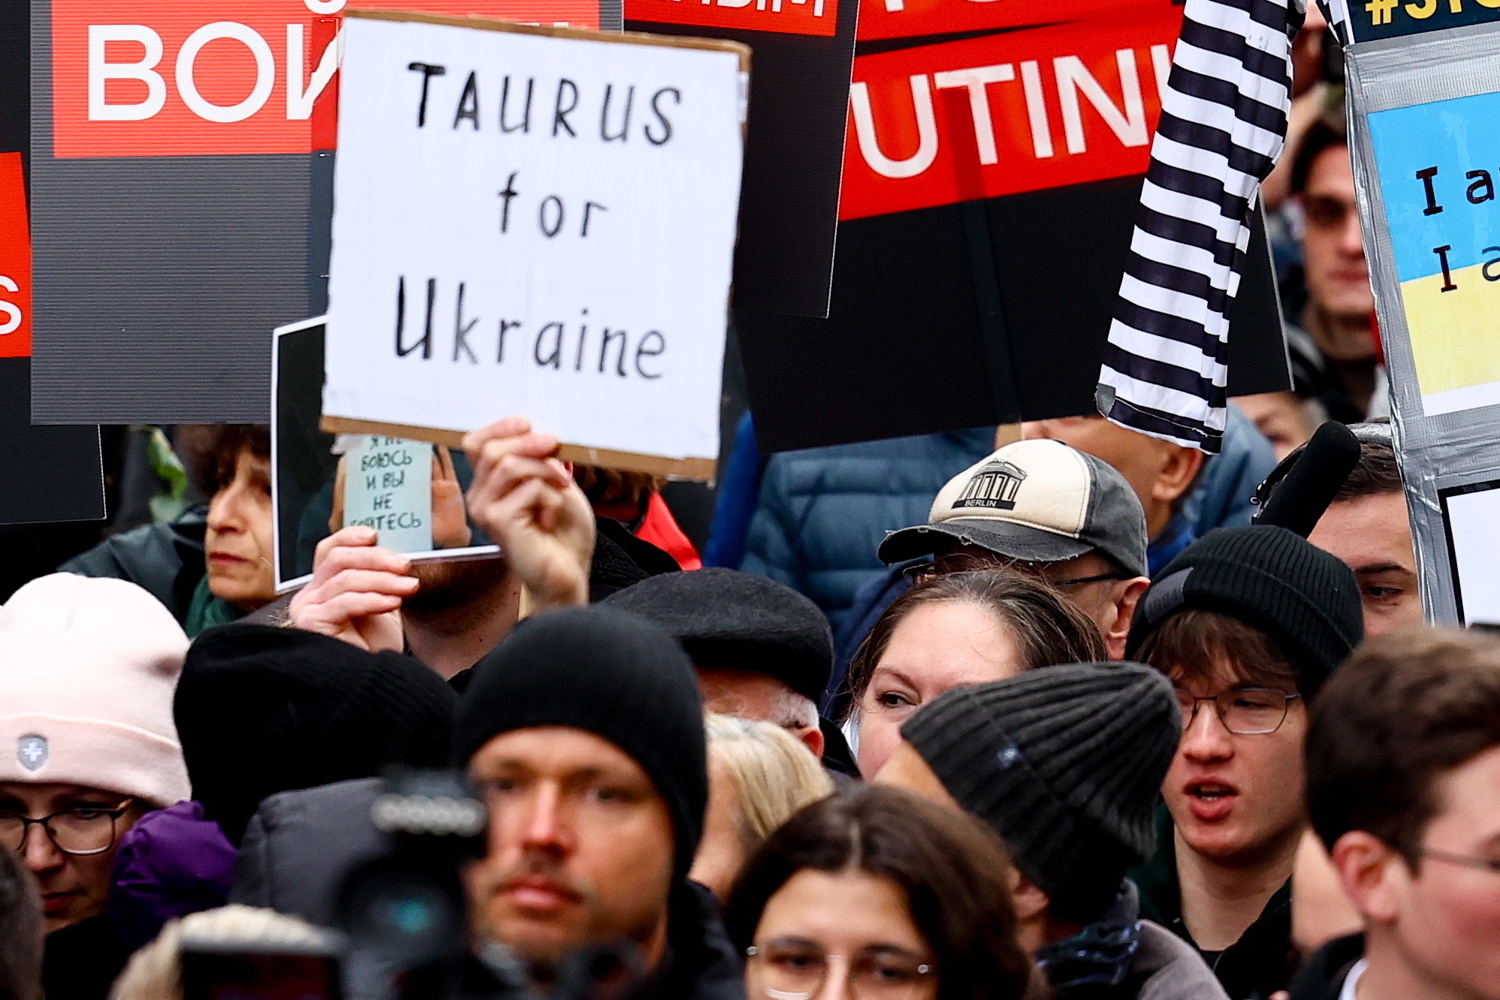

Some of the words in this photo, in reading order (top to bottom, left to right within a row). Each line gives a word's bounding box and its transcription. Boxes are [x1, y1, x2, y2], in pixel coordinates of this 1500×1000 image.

[408, 62, 683, 147] TAURUS
[498, 170, 608, 238] for
[1416, 166, 1443, 216] I
[1433, 244, 1458, 293] I
[394, 275, 666, 380] Ukraine
[964, 500, 997, 508] BERLIN
